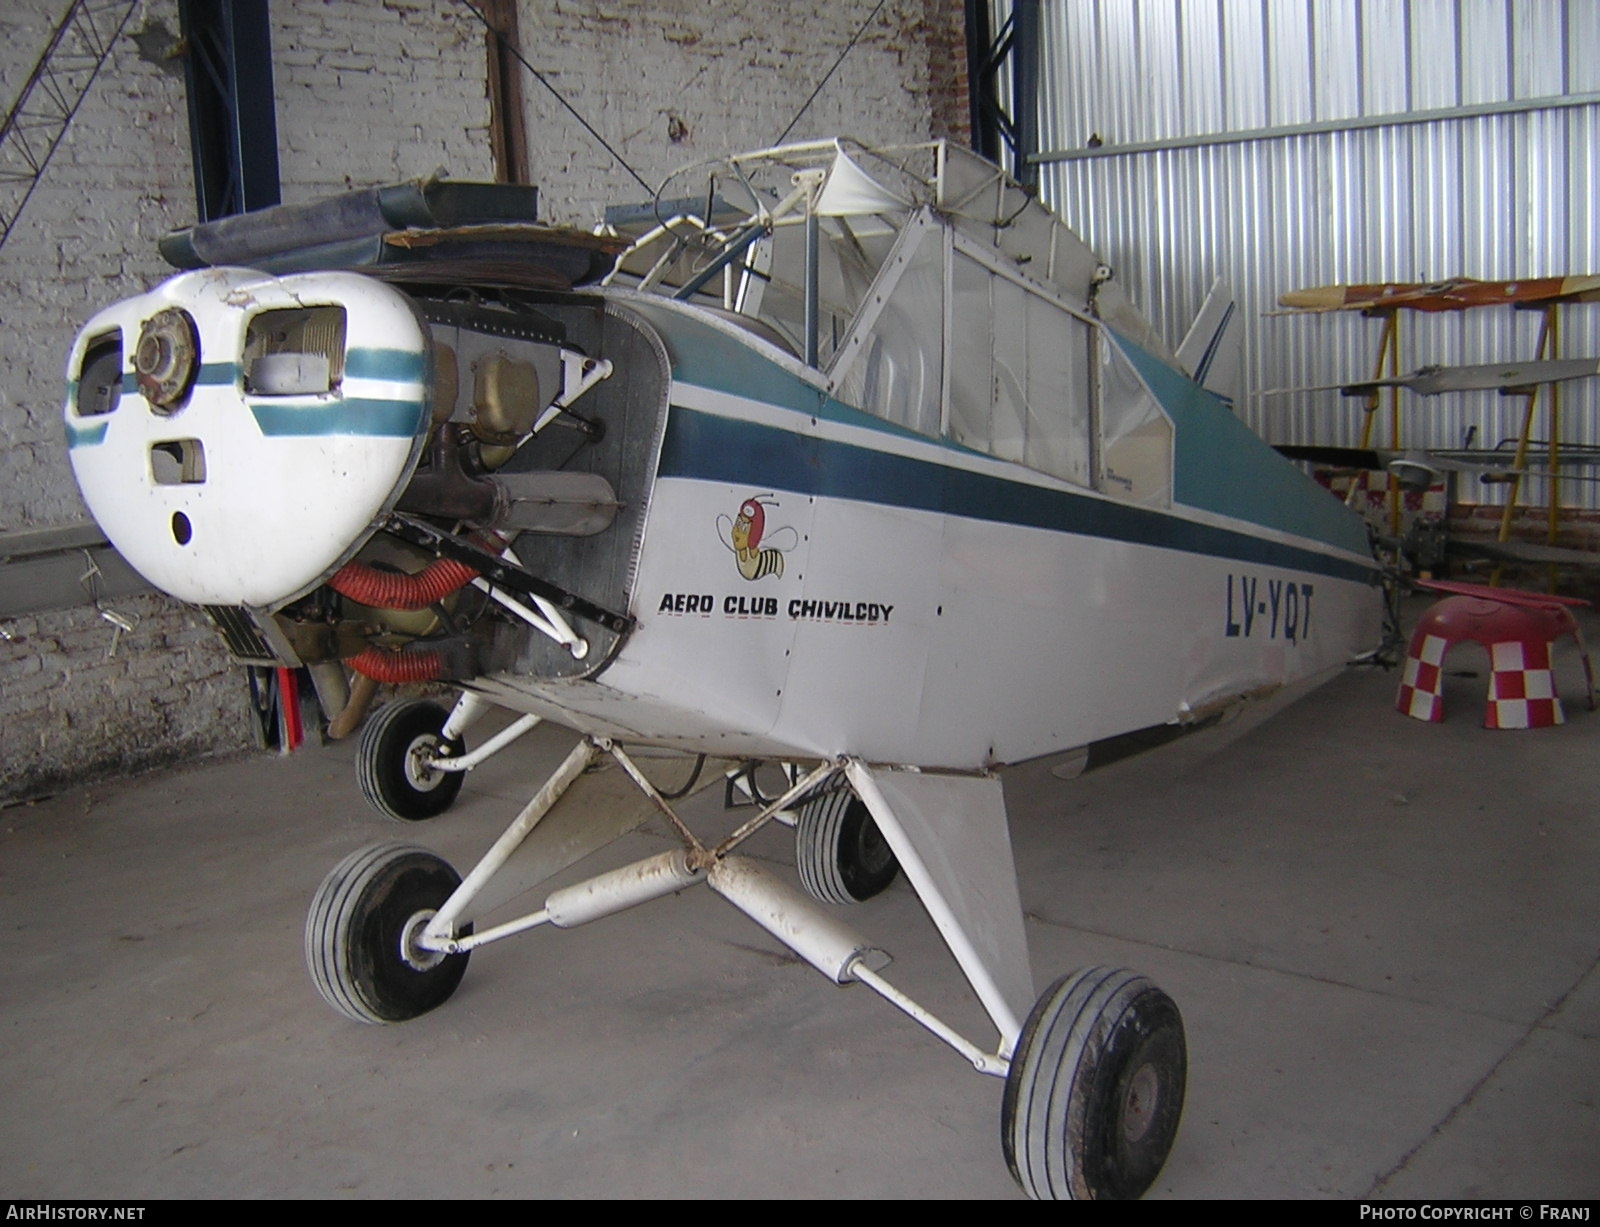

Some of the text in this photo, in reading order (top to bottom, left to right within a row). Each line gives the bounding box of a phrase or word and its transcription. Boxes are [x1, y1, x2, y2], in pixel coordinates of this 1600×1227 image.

[658, 593, 714, 615] AERO
[723, 596, 779, 617] CLUB
[1225, 573, 1314, 647] LV-YQT
